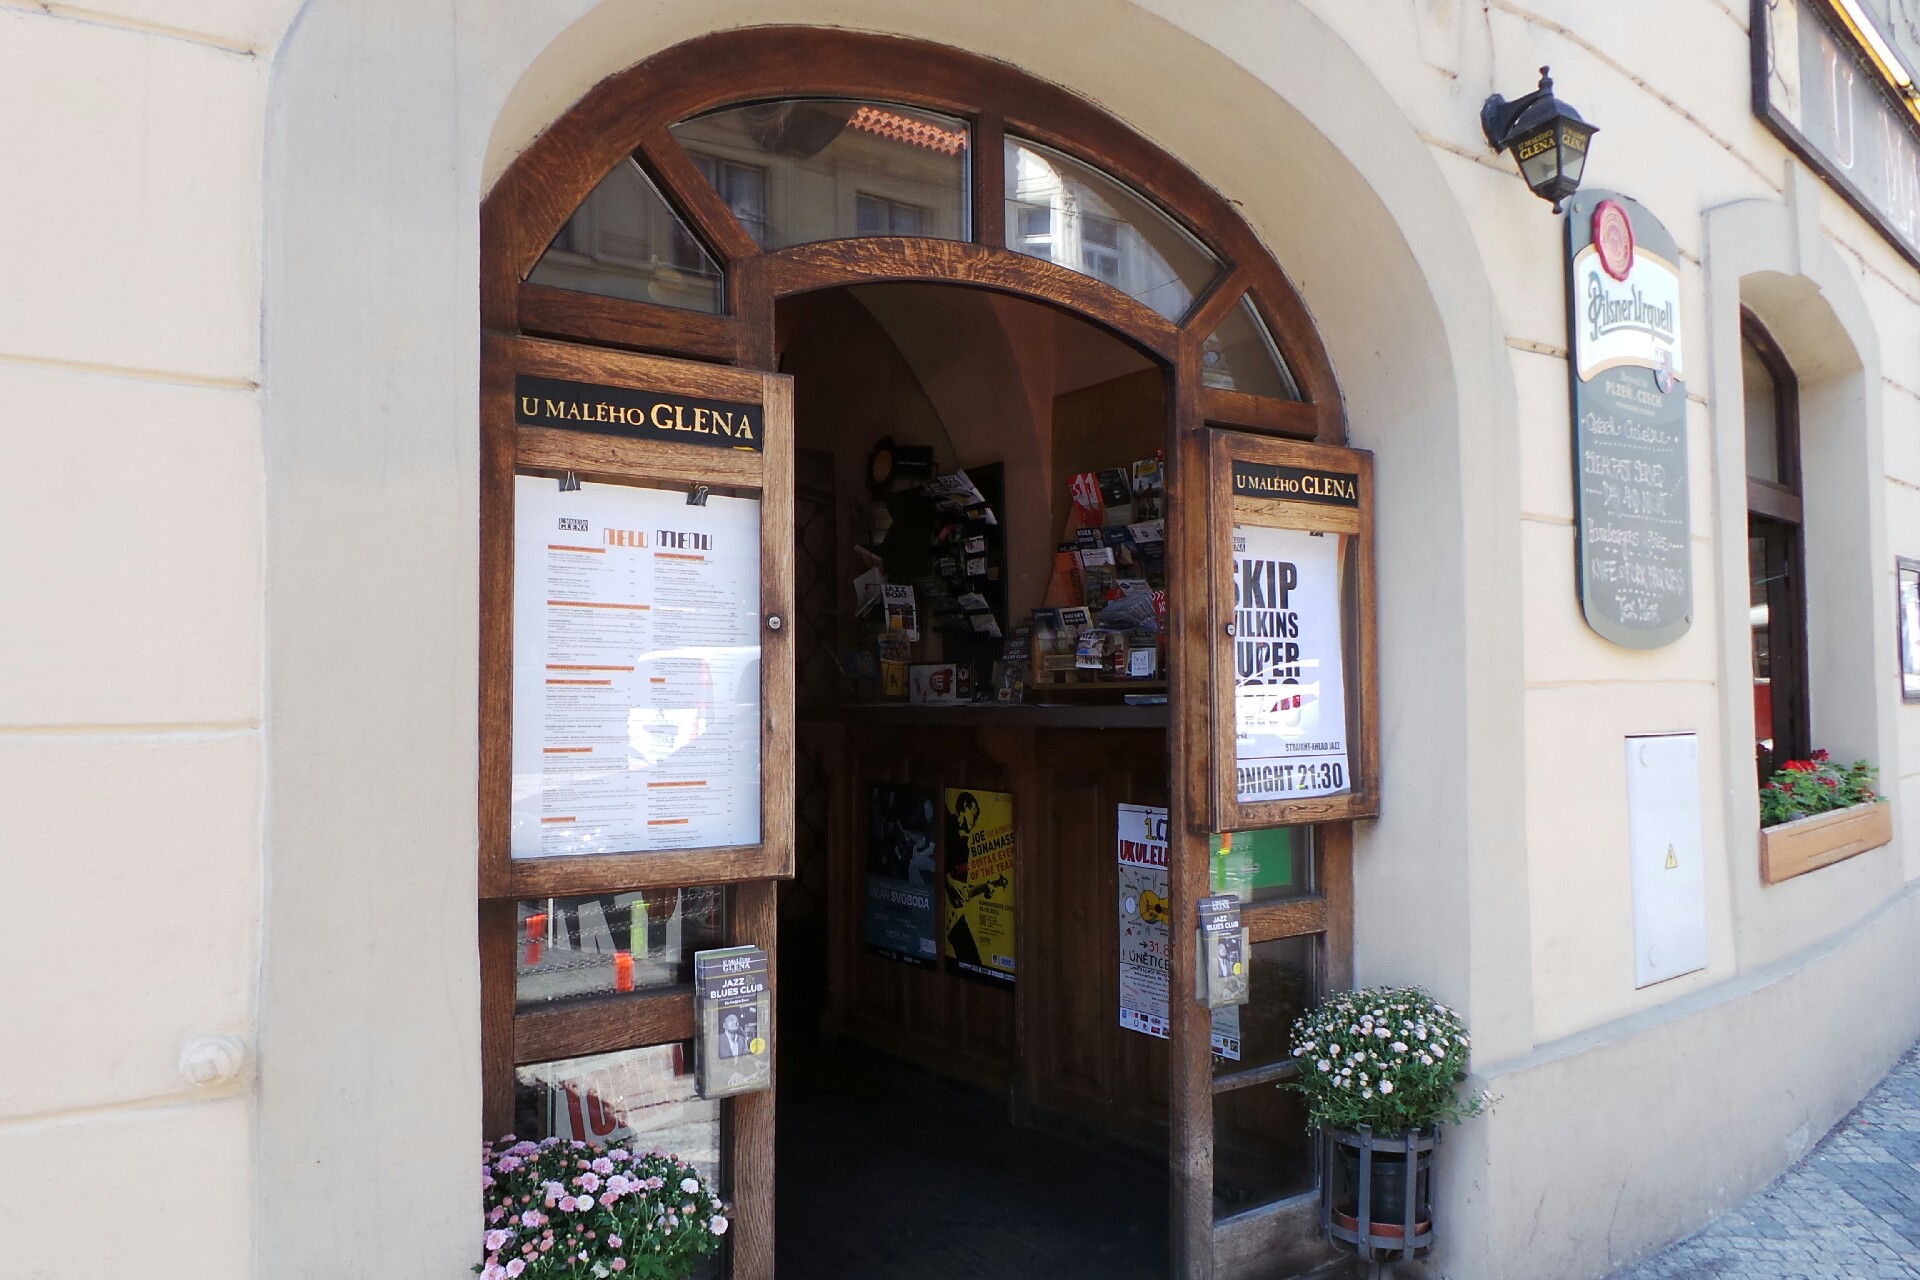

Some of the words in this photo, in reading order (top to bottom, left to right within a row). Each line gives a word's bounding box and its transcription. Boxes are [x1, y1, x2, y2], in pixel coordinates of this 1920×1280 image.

[1520, 138, 1556, 160] GLENA
[1588, 271, 1631, 341] Pilsner
[1631, 284, 1674, 341] Urquell
[521, 396, 540, 416] U
[545, 399, 645, 425] MALÉHO
[650, 402, 754, 440] GLENA
[1236, 474, 1246, 488] U
[1248, 476, 1299, 492] MALÉHO
[1301, 475, 1356, 500] GLENA
[656, 529, 713, 551] MENU
[884, 585, 906, 593] JAZZ
[885, 590, 909, 599] BOAT
[1237, 764, 1294, 795] ONIGHT
[1297, 762, 1344, 790] 21:30
[971, 830, 986, 845] JOE
[971, 854, 997, 869] GUITAR
[970, 871, 979, 880] OF
[981, 866, 995, 877] THE
[995, 860, 1014, 871] YEAR
[891, 891, 930, 910] SVOBODA
[1213, 915, 1227, 924] JAZZ
[1224, 920, 1239, 929] CLUB
[722, 962, 751, 972] GLENA
[722, 978, 745, 989] JAZZ
[710, 987, 739, 999] BLUES
[739, 984, 764, 994] CLUB
